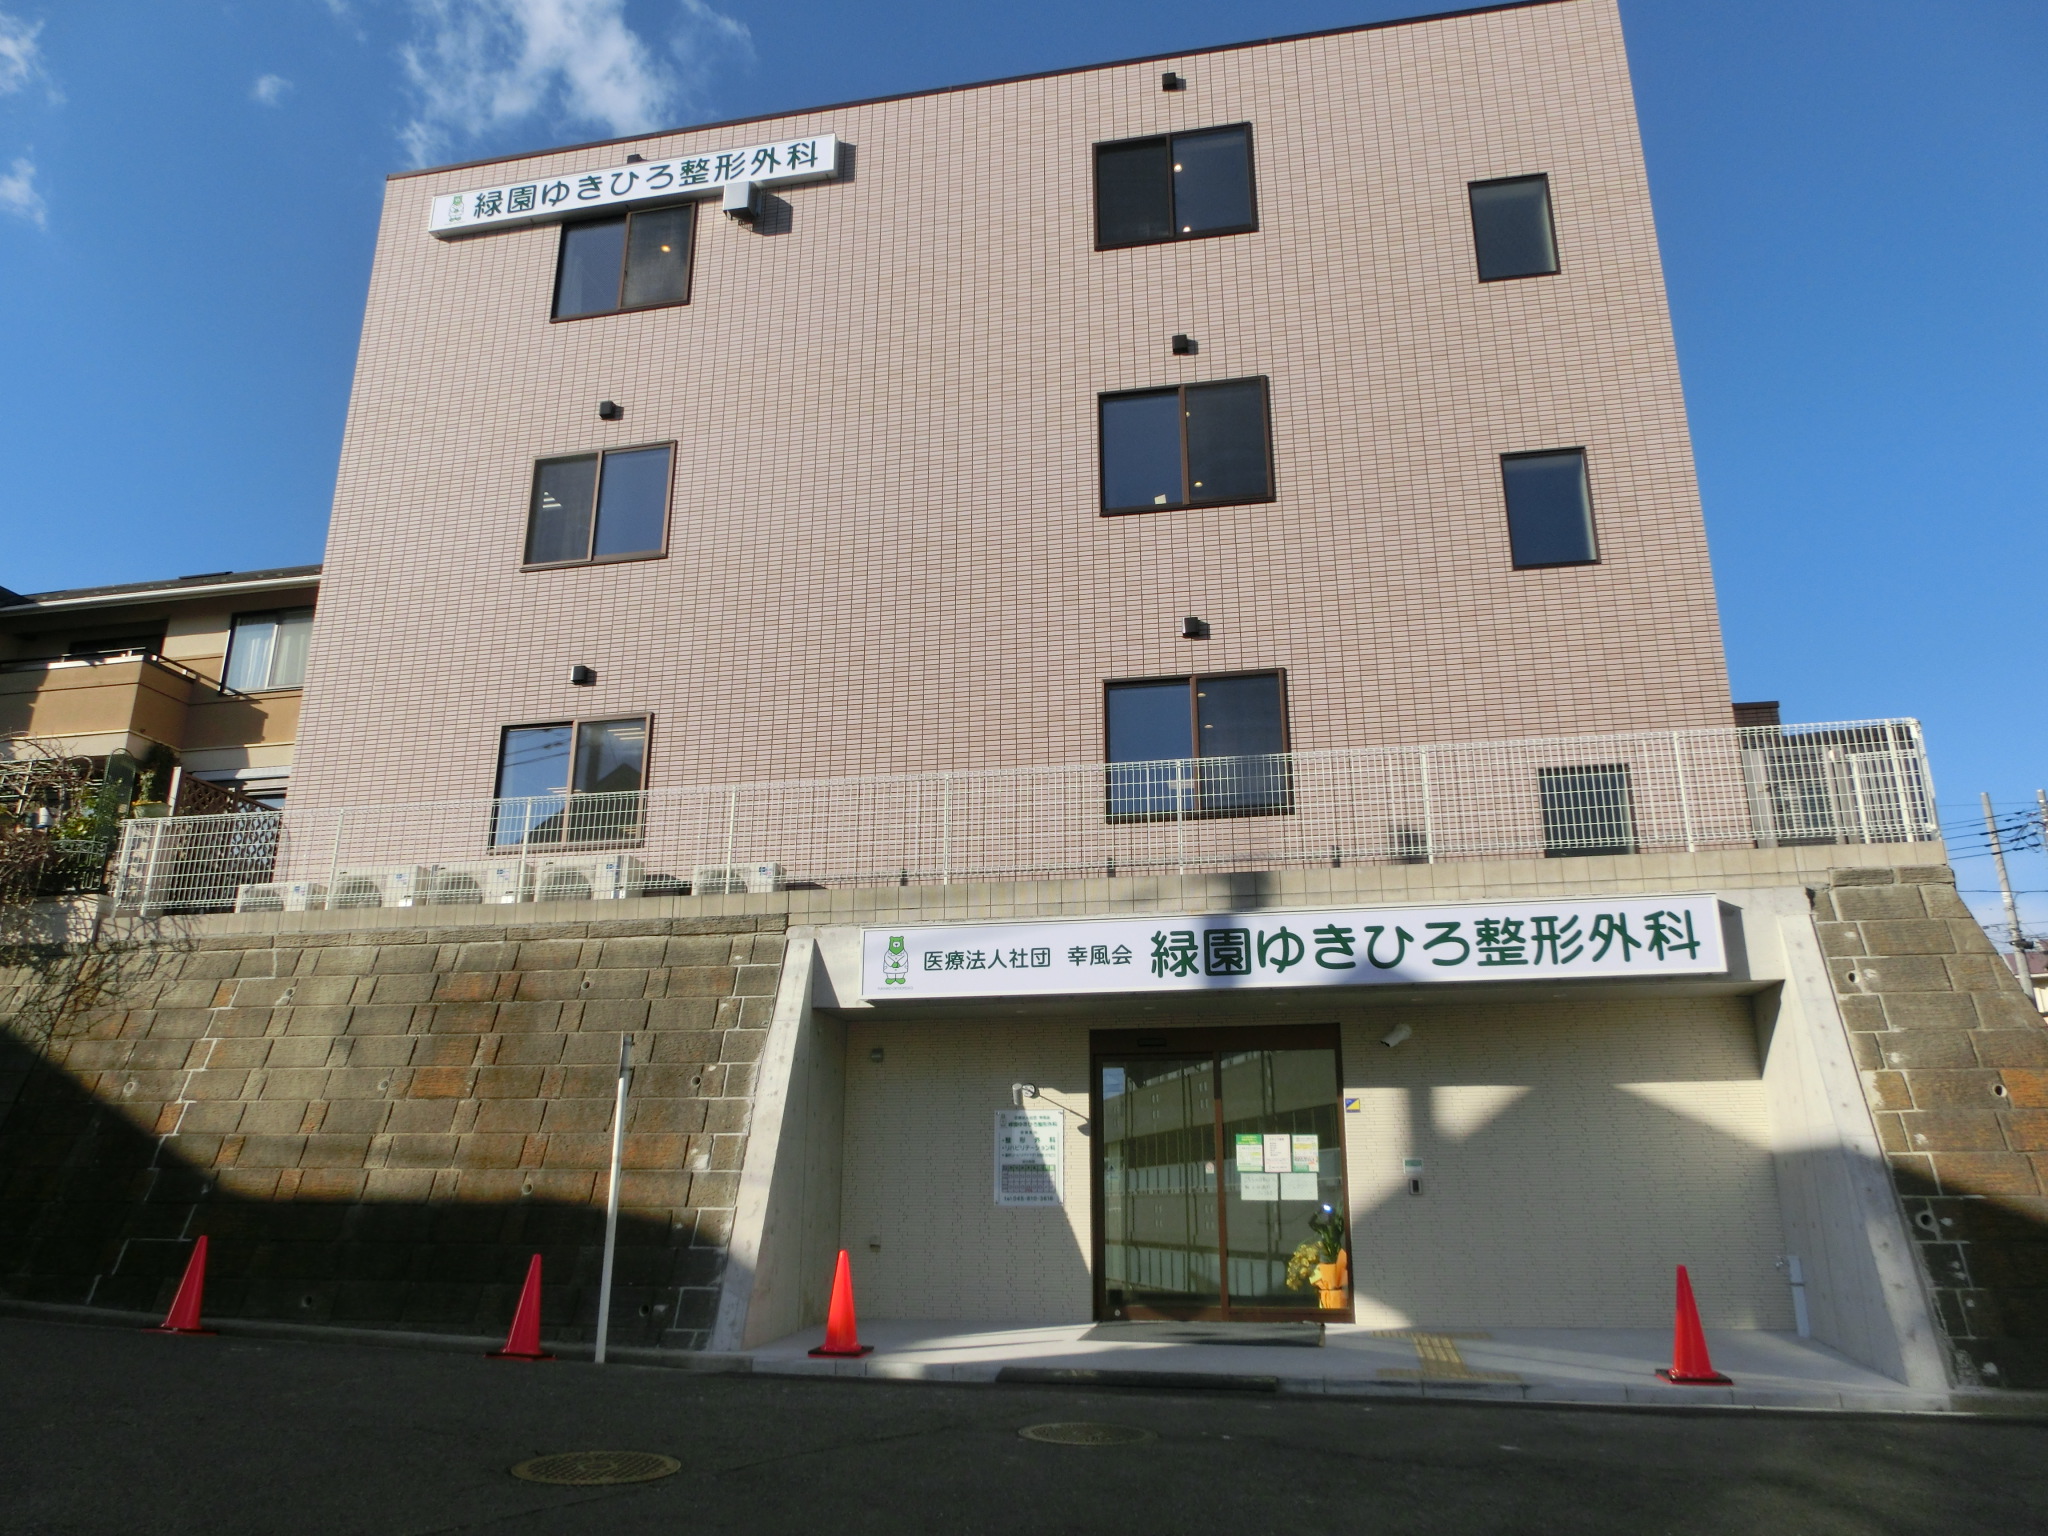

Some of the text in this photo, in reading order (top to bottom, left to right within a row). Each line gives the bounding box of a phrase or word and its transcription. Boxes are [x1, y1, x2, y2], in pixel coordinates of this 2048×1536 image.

[472, 140, 819, 219] 緑園ゆきひろ整形外科
[923, 909, 1701, 979] 医療法人社団 幸風会 緑園ゆきひろ整形外科
